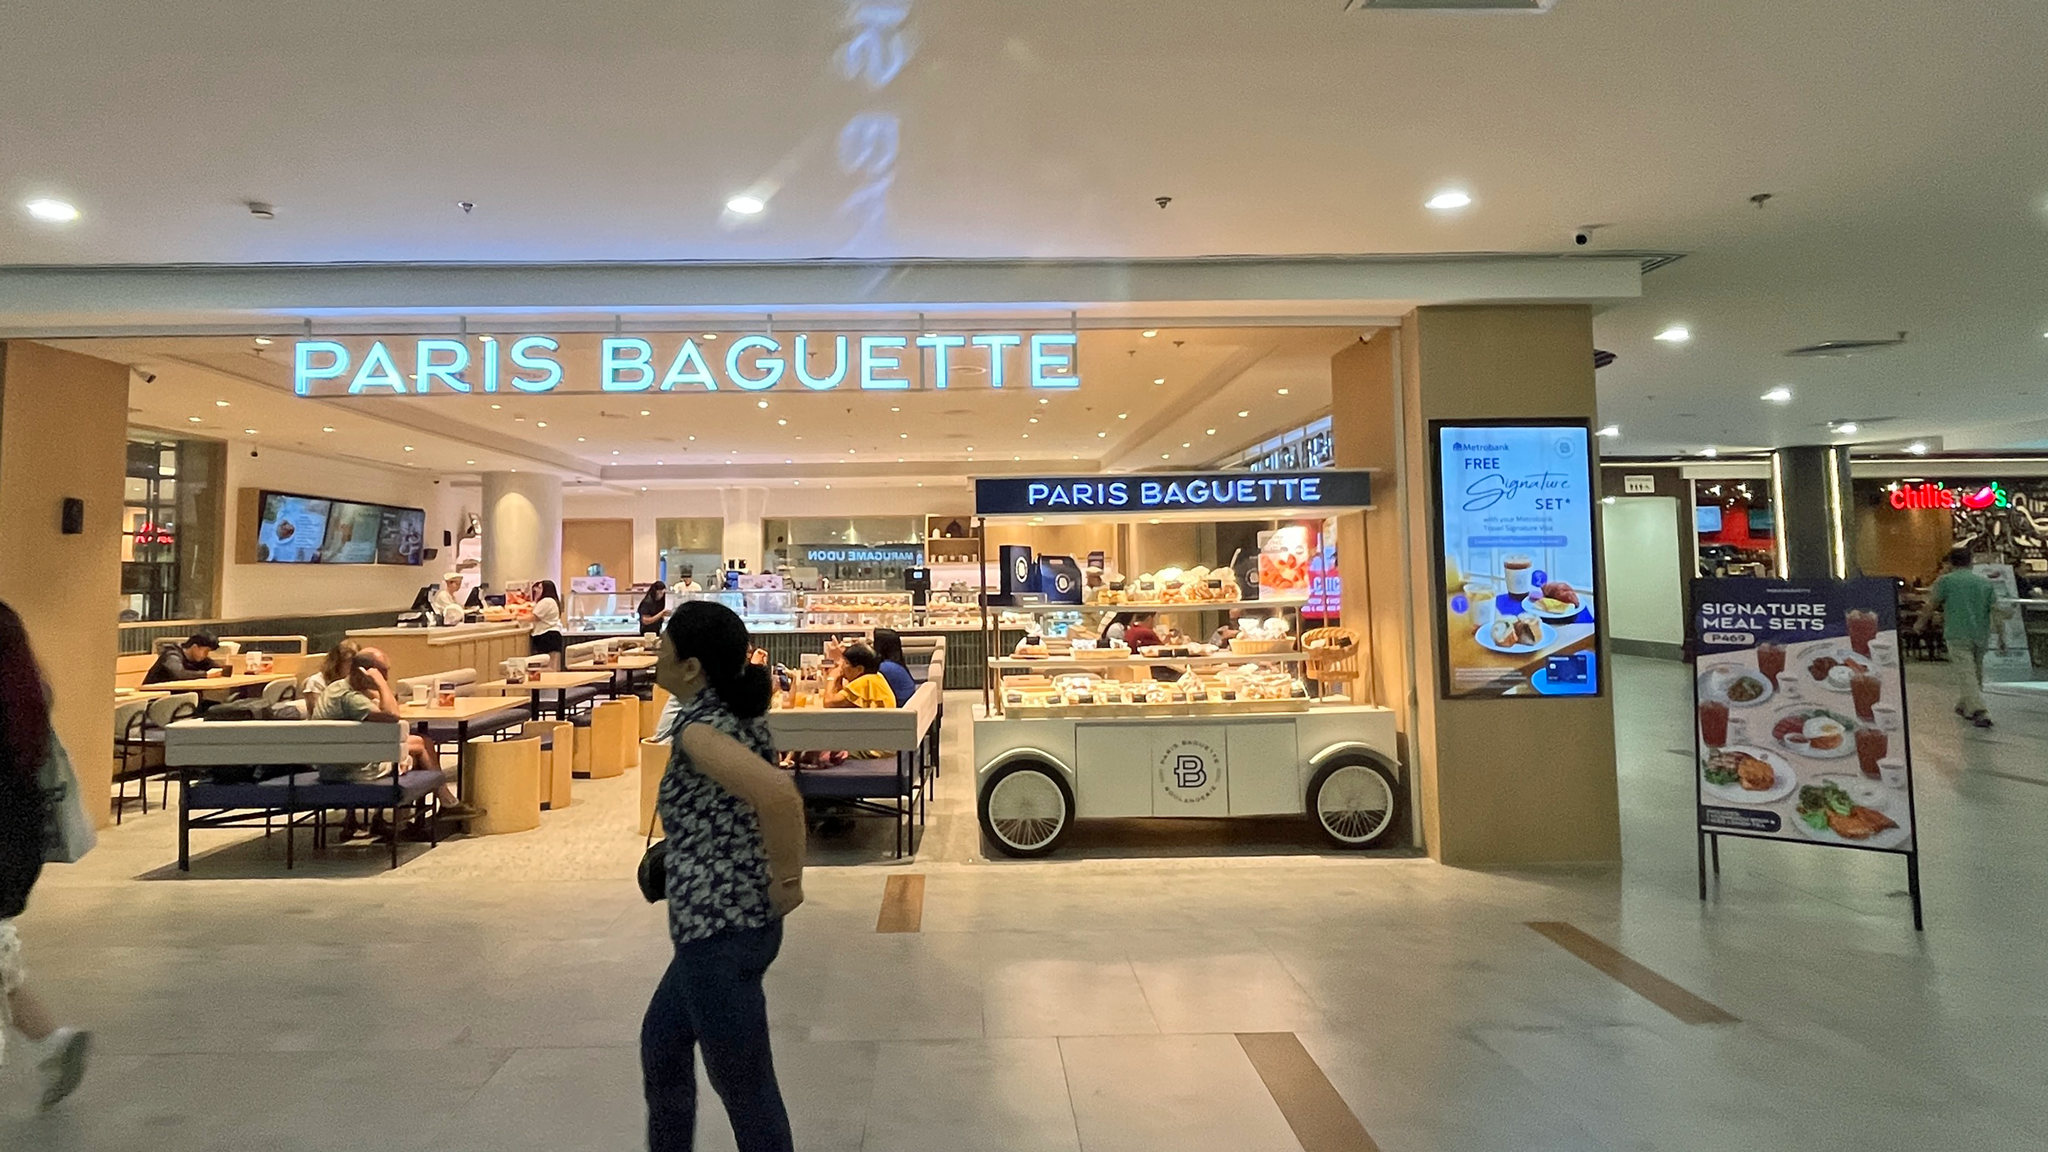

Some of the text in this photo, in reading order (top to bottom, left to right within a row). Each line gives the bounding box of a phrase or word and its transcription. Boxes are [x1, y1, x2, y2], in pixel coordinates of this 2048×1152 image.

[294, 335, 1081, 395] PARIS BAGUETTE
[1463, 443, 1509, 452] Metrobank
[1465, 457, 1500, 470] FREE
[1028, 478, 1322, 506] PARIS BAGUETTE
[1462, 471, 1571, 512] Signature
[1702, 603, 1827, 616] SIGNATURE
[1703, 617, 1825, 630] MEAL SETS
[1712, 634, 1746, 642] P469
